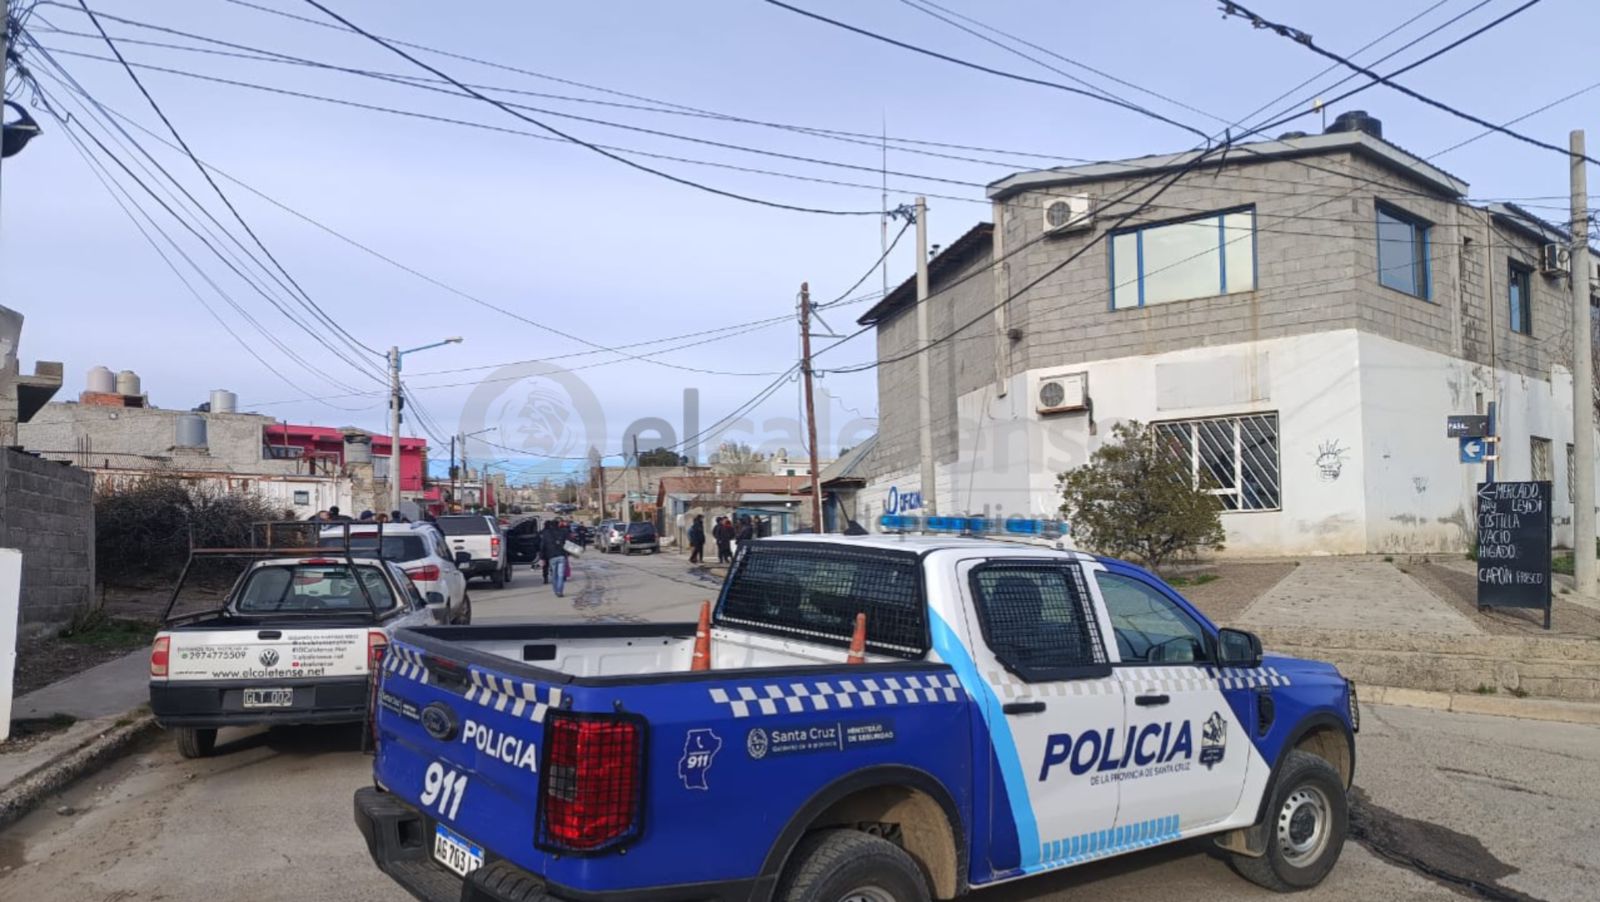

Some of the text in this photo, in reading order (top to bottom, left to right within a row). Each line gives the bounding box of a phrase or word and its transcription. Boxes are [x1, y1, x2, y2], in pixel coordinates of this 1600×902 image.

[1478, 512, 1521, 529] COSTILLA
[462, 719, 537, 773] POLICIA
[771, 727, 836, 743] Santa Cruz
[687, 754, 709, 769] 911
[1038, 719, 1193, 782] POLICIA
[1090, 761, 1191, 786] DE LA PROVINCIA DE SANTA CRUZ
[420, 761, 468, 821] 911
